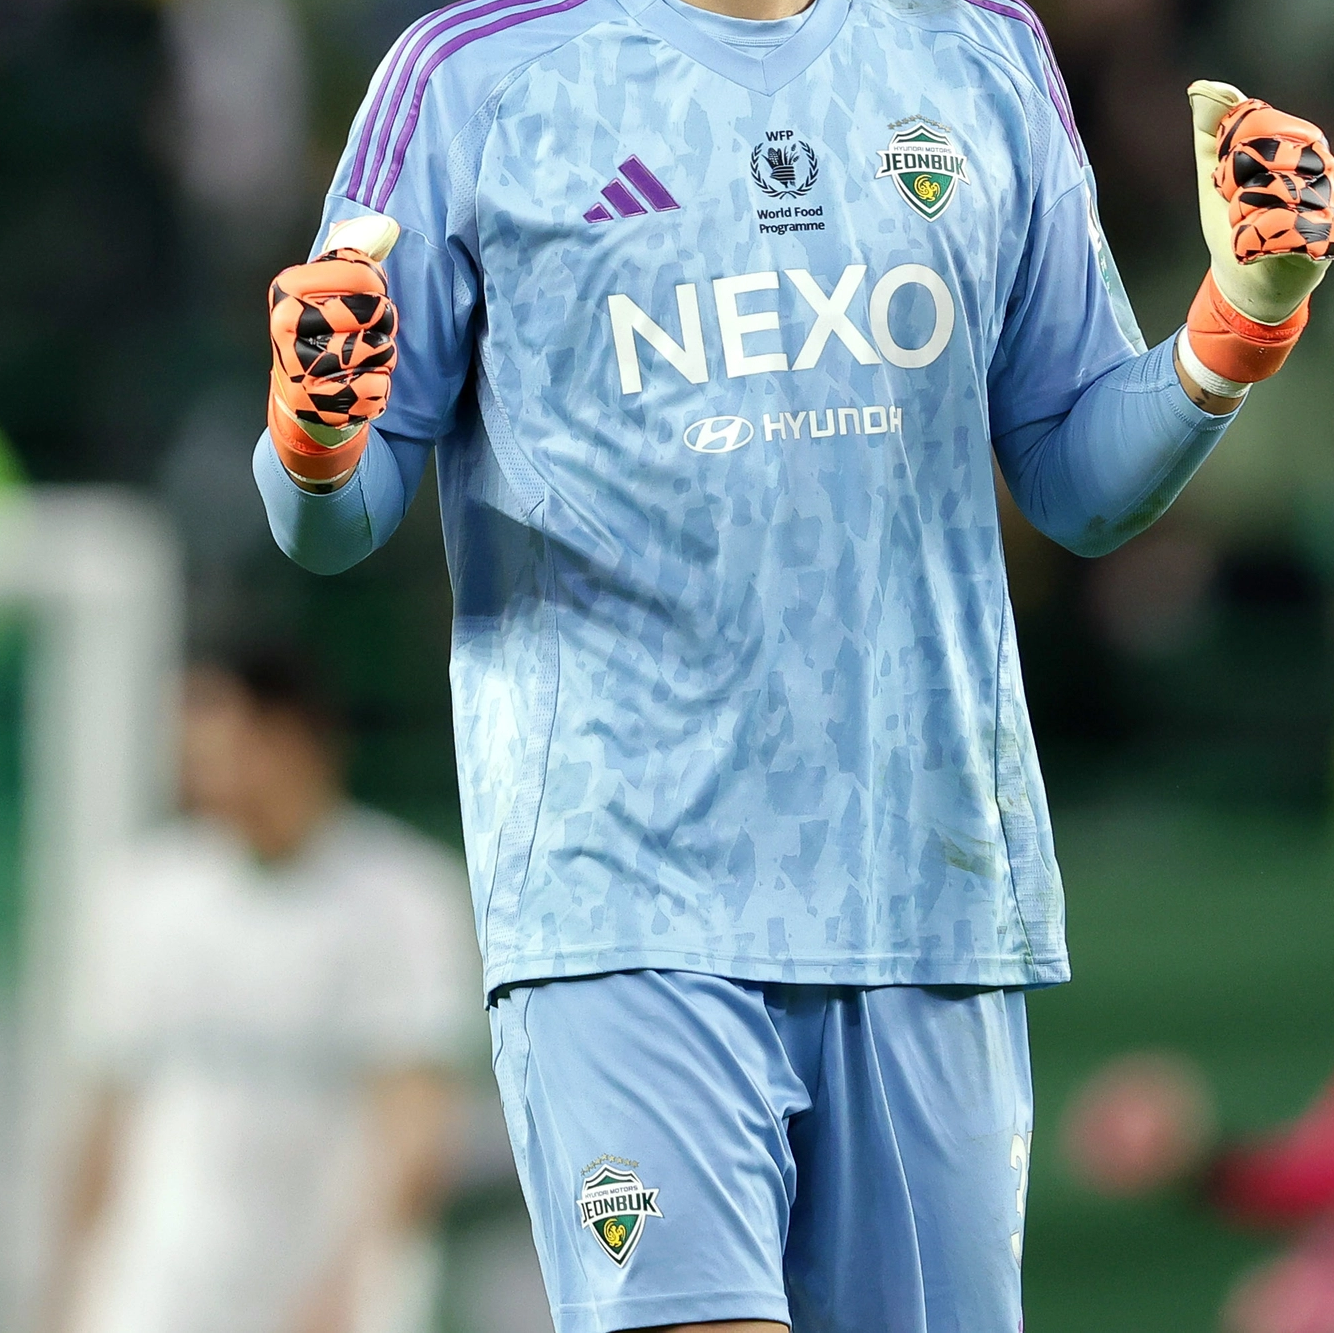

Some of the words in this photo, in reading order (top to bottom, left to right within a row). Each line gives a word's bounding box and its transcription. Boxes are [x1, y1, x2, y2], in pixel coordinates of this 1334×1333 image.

[765, 129, 794, 142] WFP
[893, 145, 924, 153] HYUNDAI
[882, 152, 967, 179] JEONBUK
[757, 207, 792, 220] World
[794, 205, 823, 218] Food
[759, 221, 825, 236] Programme
[607, 263, 955, 395] NEXO
[610, 1185, 638, 1194] MOTORS
[581, 1192, 656, 1223] JEONBUK
